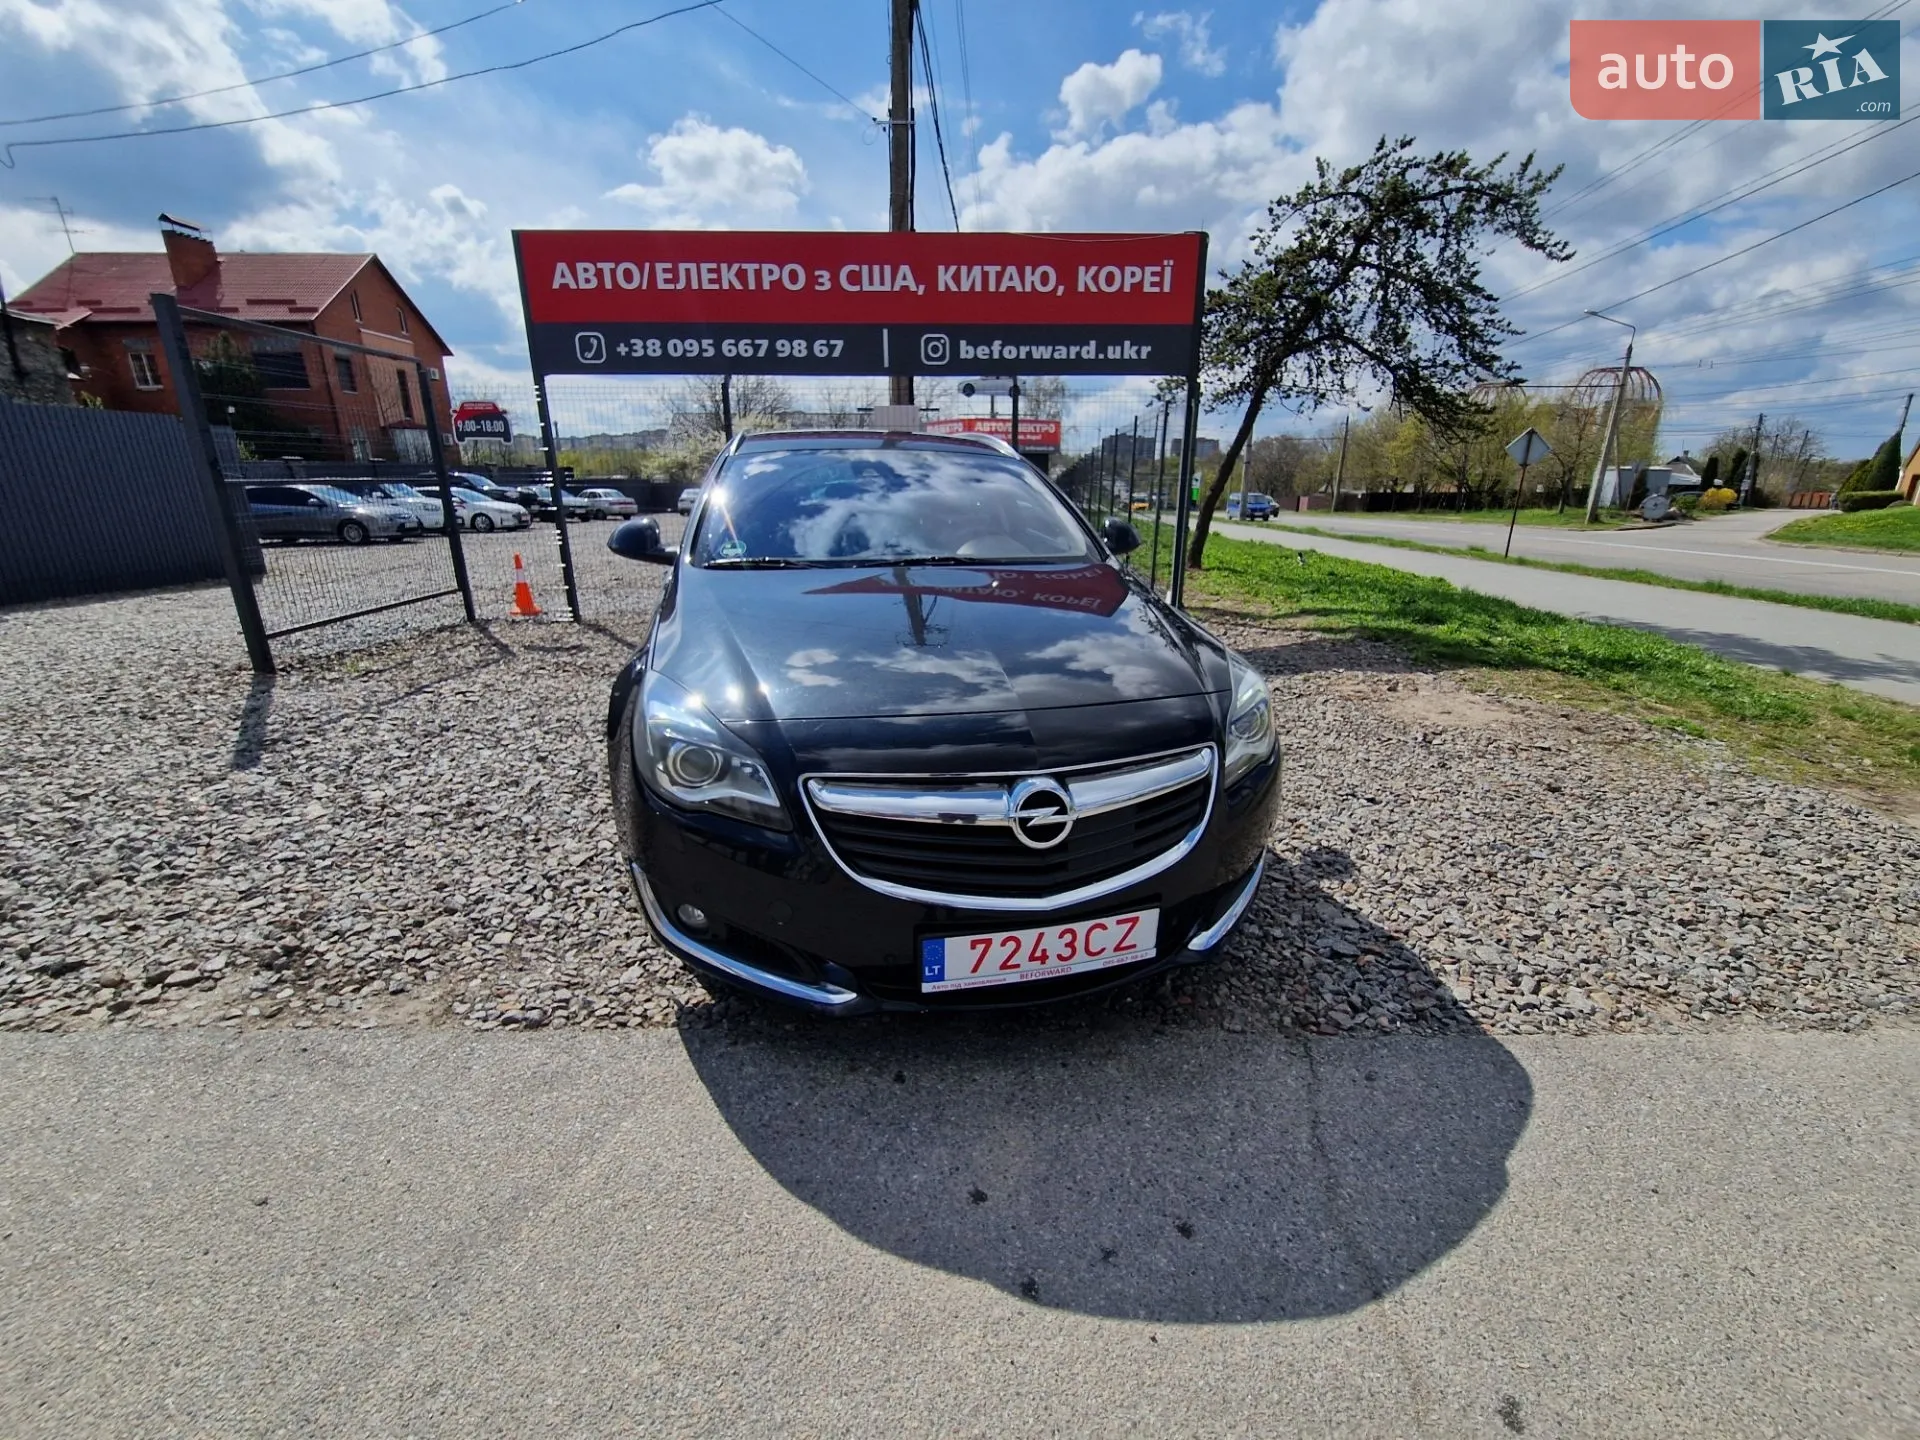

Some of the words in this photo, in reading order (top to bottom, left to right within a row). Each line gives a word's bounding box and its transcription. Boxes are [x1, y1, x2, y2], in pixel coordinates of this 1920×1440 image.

[839, 264, 926, 295] США,
[937, 265, 1065, 296] КИТАЮ,
[1077, 260, 1174, 292] КОРЕЇ
[616, 338, 662, 358] +38
[667, 338, 716, 358] 095
[721, 339, 768, 358] 667
[775, 339, 808, 358] 98
[813, 339, 844, 358] 67
[959, 340, 1152, 359] beforward.ukr
[970, 916, 1140, 974] 7243CZ
[925, 965, 941, 976] LT
[1019, 966, 1072, 980] BEFORWARD
